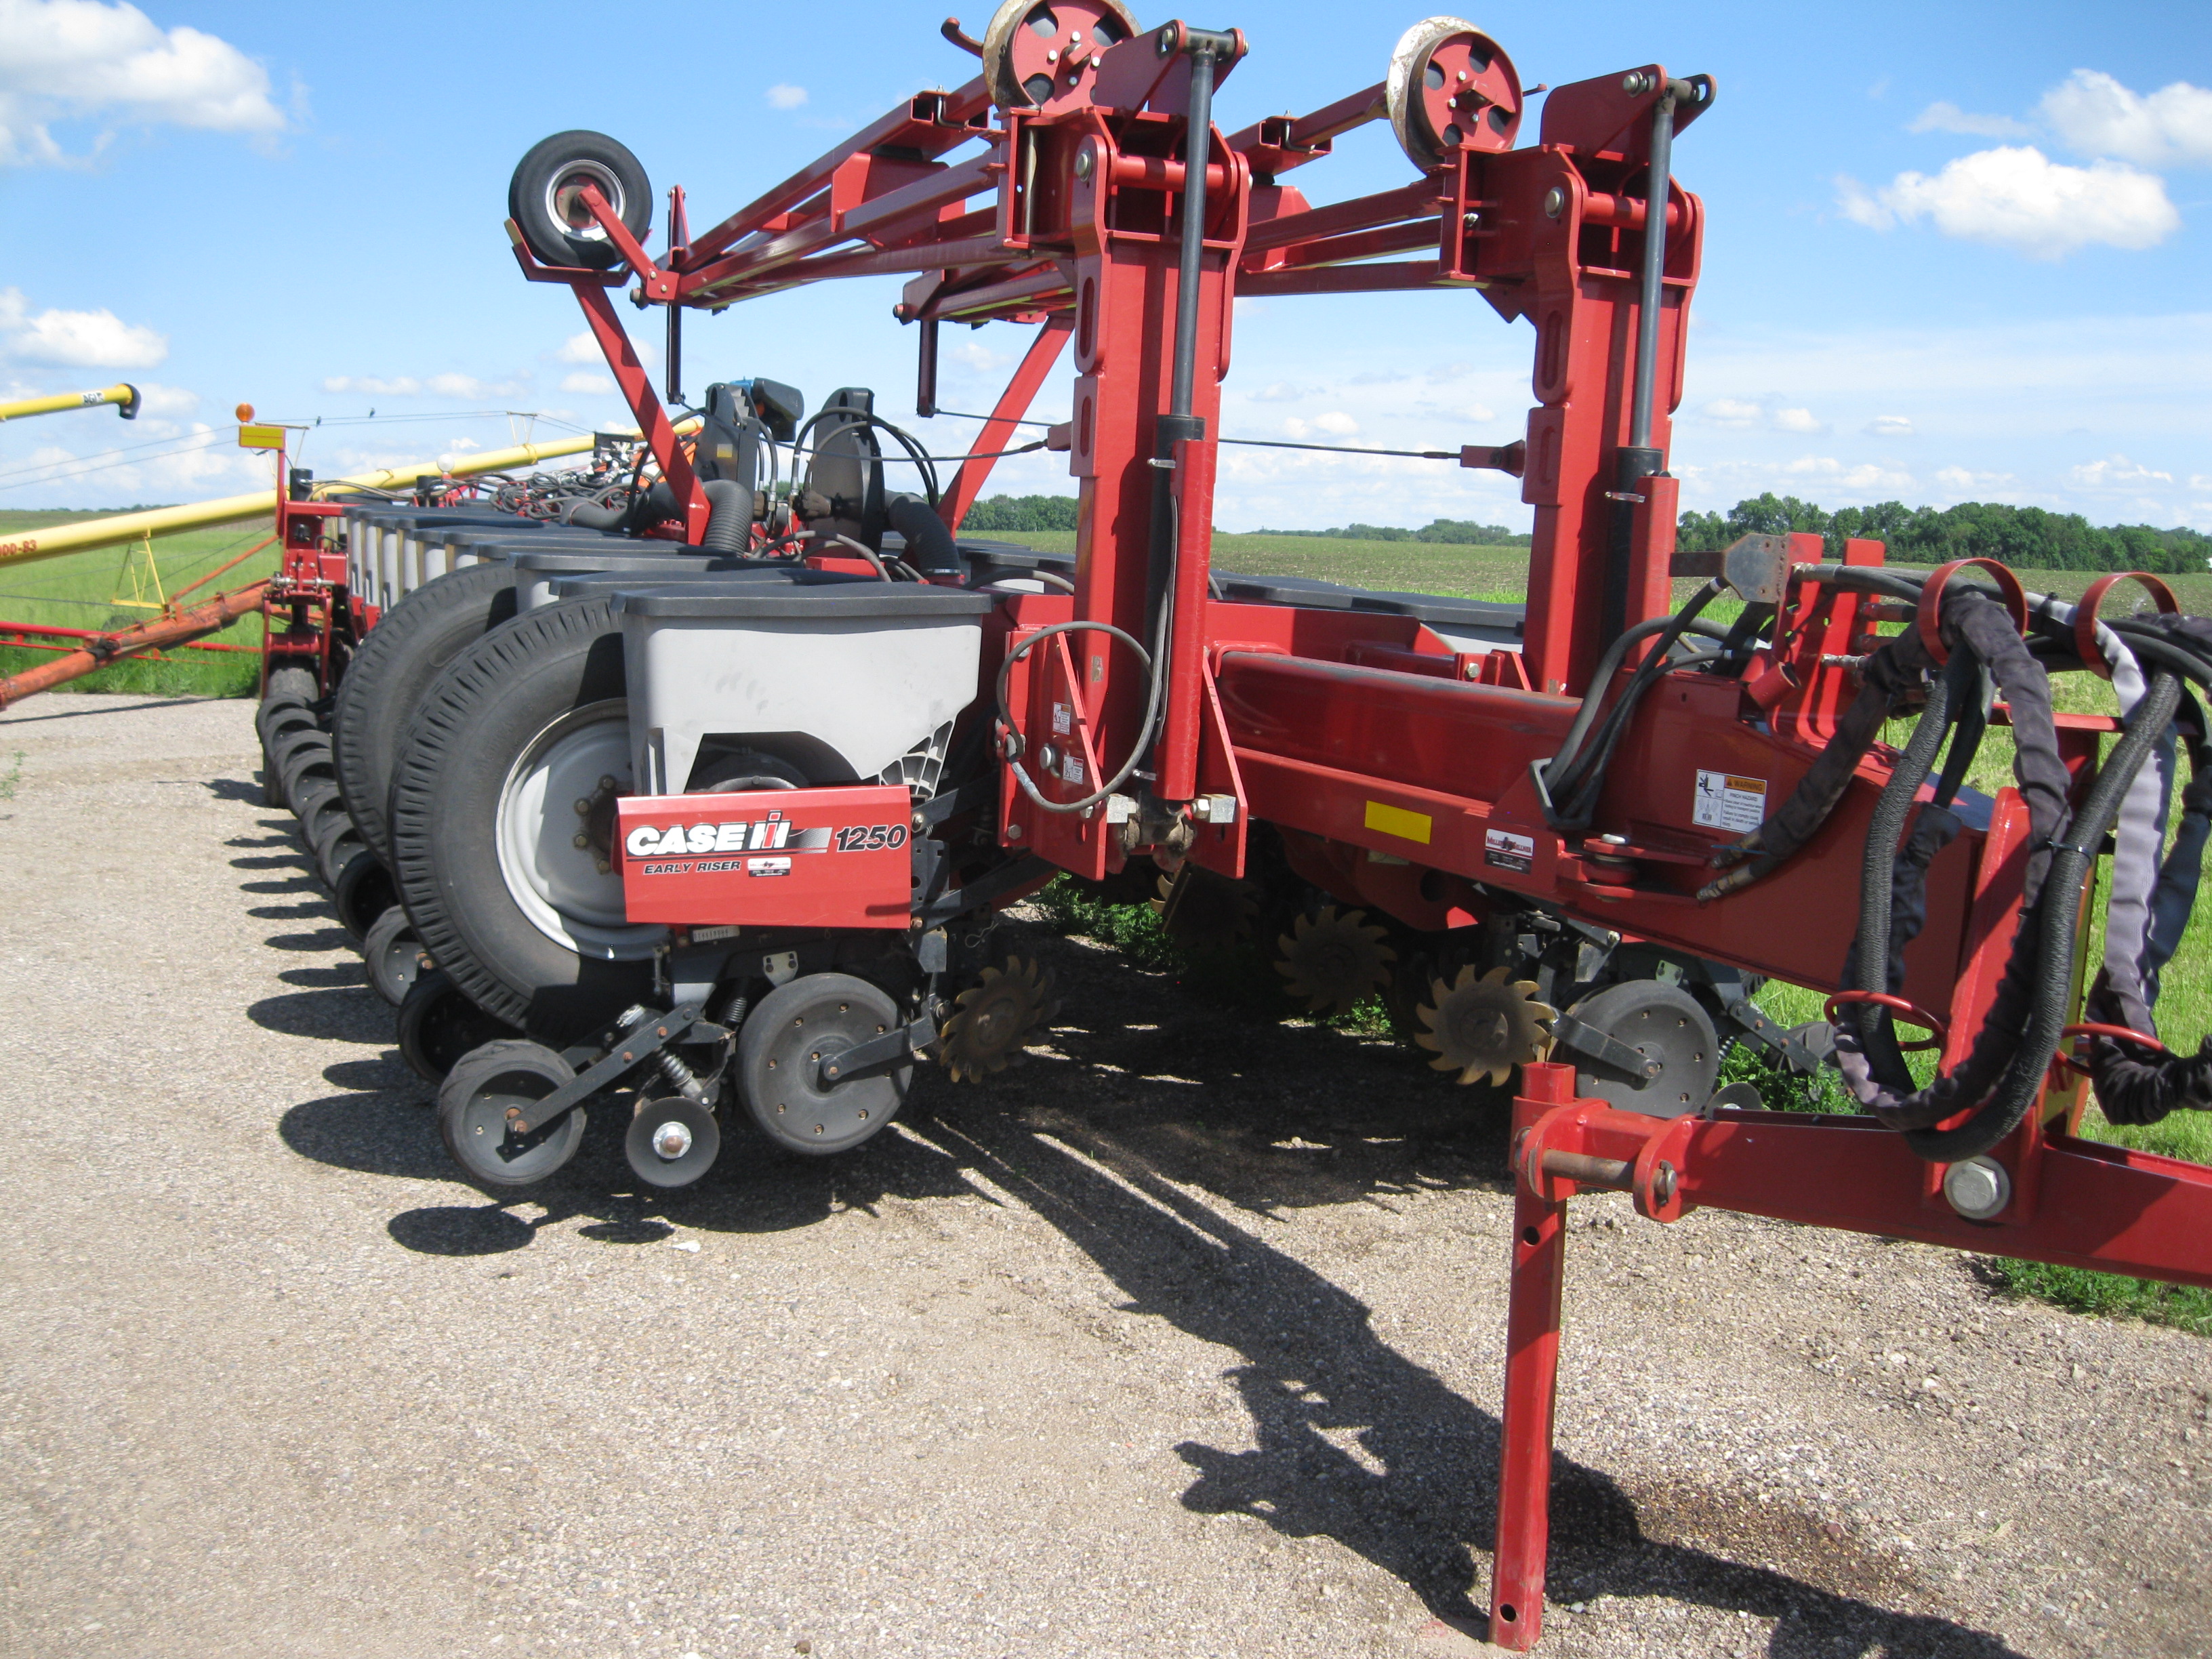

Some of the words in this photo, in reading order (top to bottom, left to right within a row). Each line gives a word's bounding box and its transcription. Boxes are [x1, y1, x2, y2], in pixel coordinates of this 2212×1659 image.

[1734, 779, 1762, 792] WARNING
[626, 822, 747, 857] CASE
[835, 823, 908, 853] 1250
[643, 862, 694, 876] EARLY
[695, 861, 741, 873] RISER
